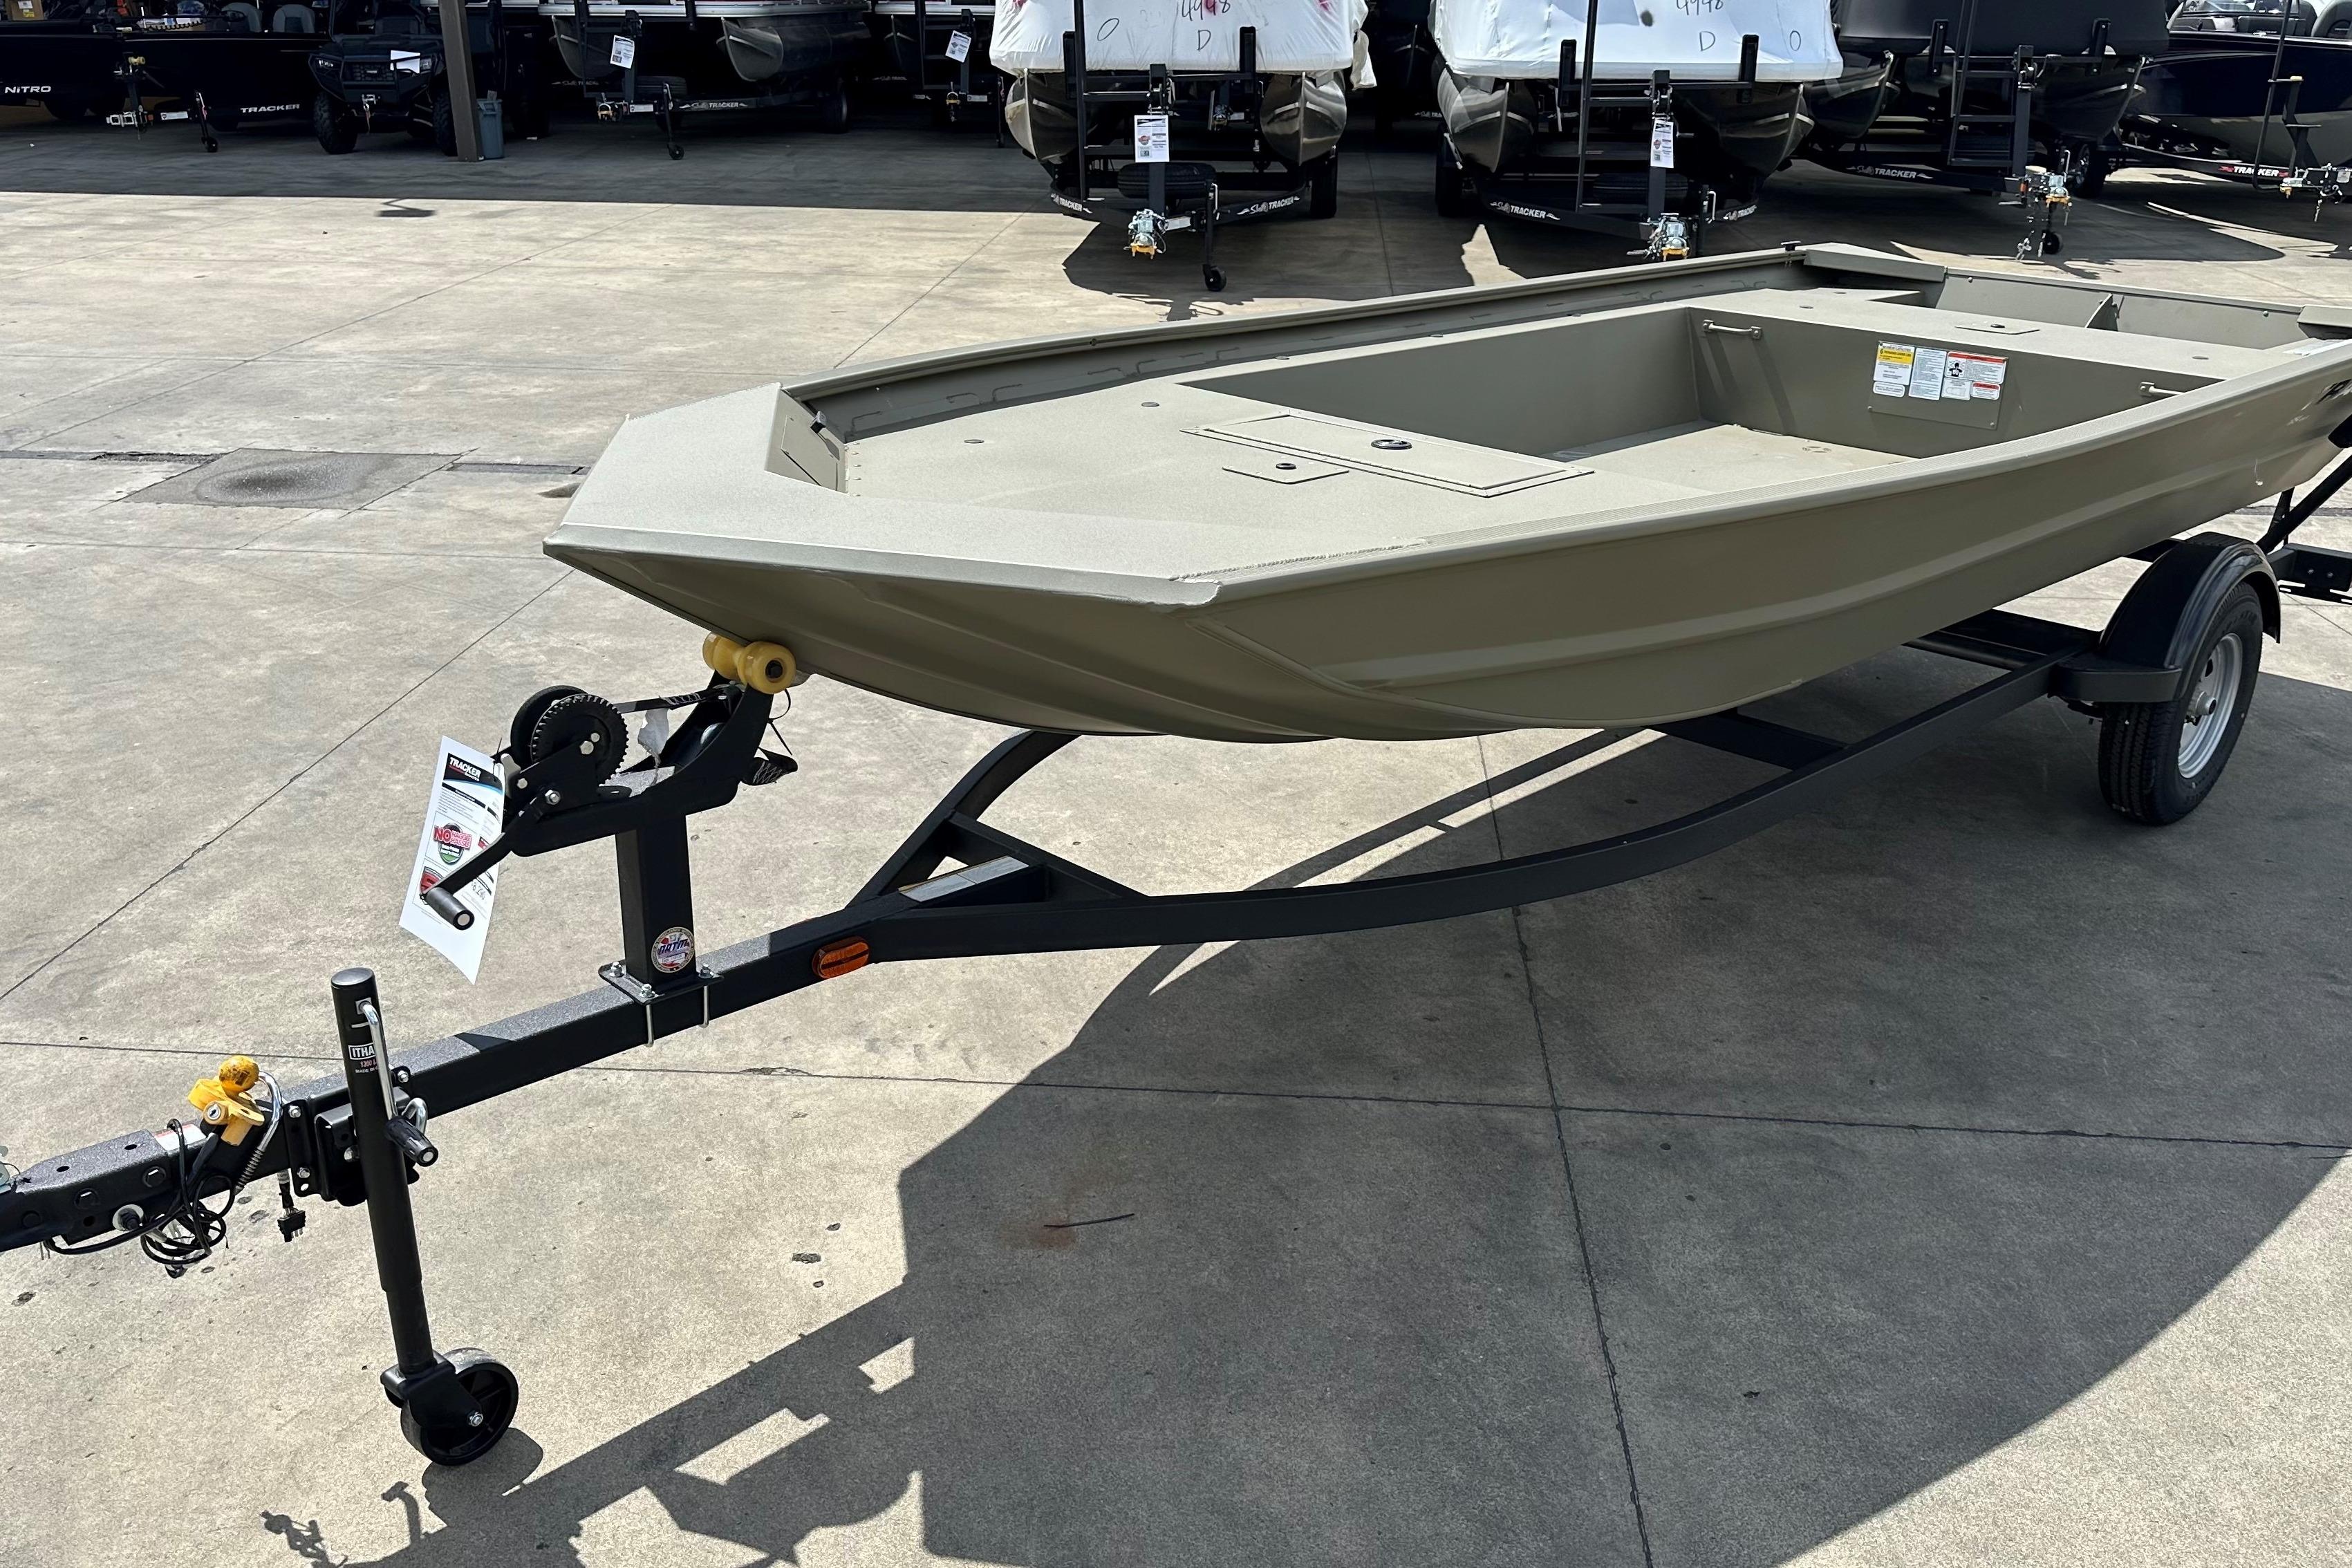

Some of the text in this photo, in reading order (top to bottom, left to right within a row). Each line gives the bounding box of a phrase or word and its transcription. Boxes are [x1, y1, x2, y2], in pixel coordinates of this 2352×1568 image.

[1699, 31, 1715, 52] D
[240, 104, 300, 113] TRACKER
[1874, 168, 1917, 179] TRACKER
[1511, 205, 1546, 218] TRACKER
[449, 757, 481, 778] TRACKER
[433, 825, 451, 843] NO
[352, 1045, 375, 1058] ITHA
